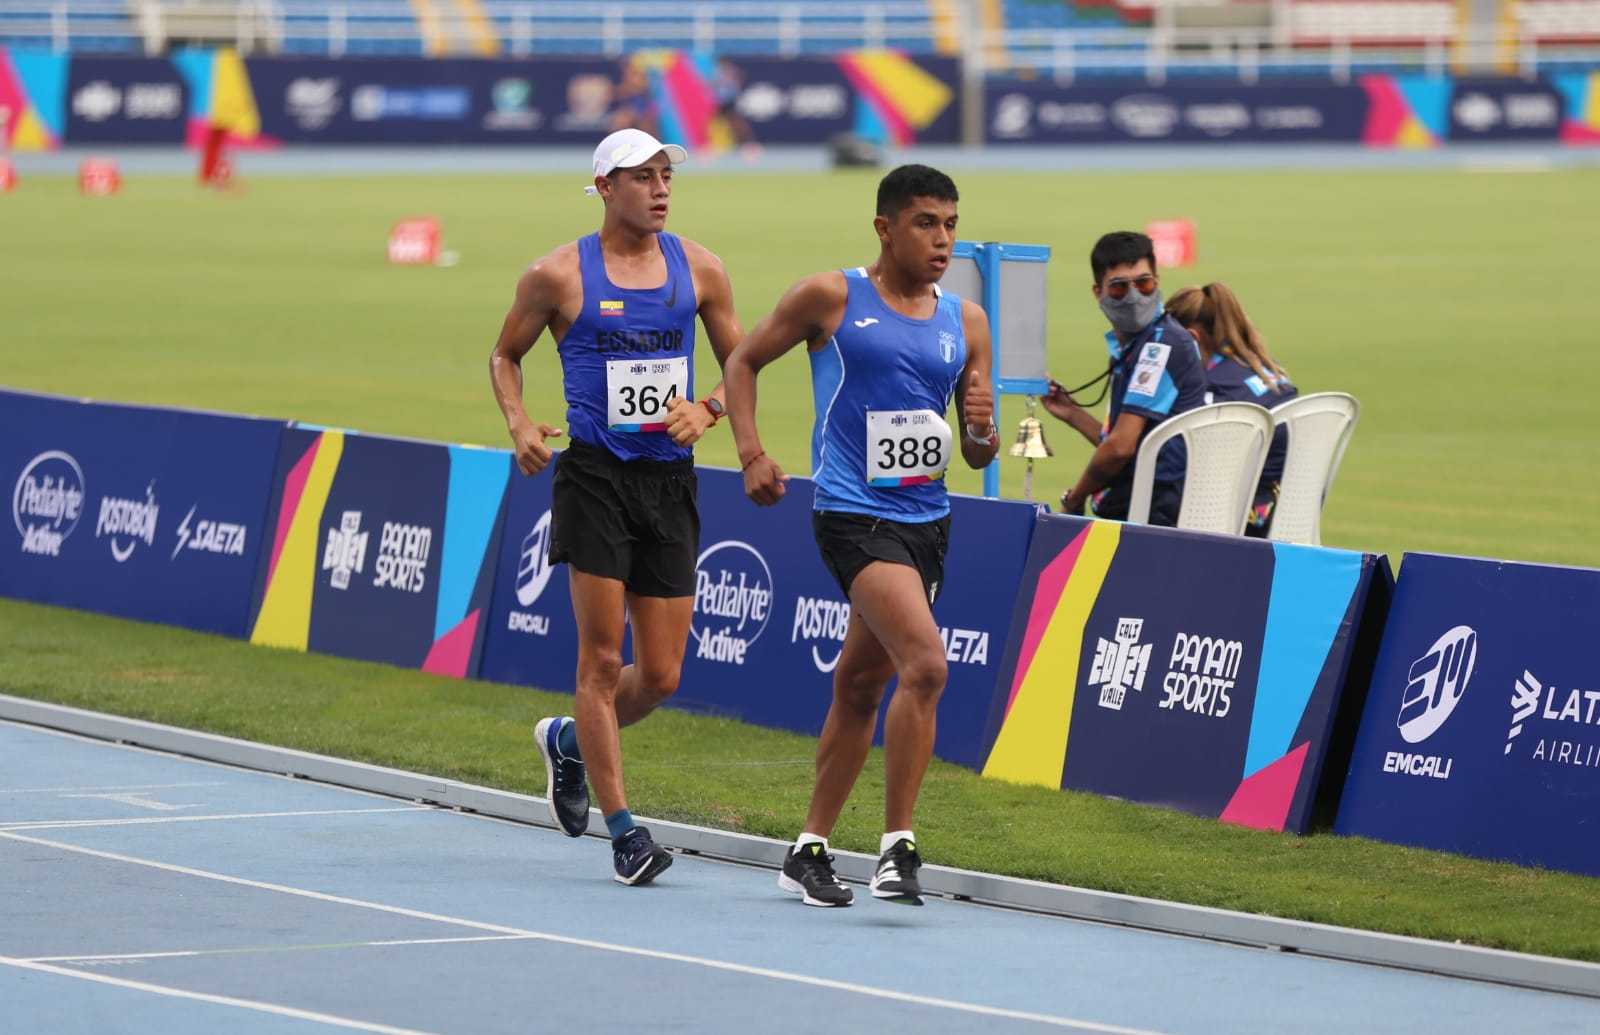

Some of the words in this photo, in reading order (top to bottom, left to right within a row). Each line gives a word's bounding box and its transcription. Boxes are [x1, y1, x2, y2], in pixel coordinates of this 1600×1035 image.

[596, 329, 684, 353] ECUADOR
[618, 384, 677, 417] 364
[877, 436, 942, 470] 388
[20, 474, 82, 529] Pedialyte
[22, 523, 63, 557] Active
[188, 520, 246, 556] SAETA
[379, 521, 432, 559] PANAM
[373, 553, 427, 593] SPORTS
[694, 569, 770, 631] Pedialyte
[507, 611, 550, 636] EMCALI
[792, 596, 850, 643] POSTOB
[1119, 623, 1140, 639] CALI
[697, 626, 746, 665] Active
[936, 626, 989, 665] ETA
[1168, 632, 1243, 679] PANAM
[1102, 687, 1123, 706] VALLE
[1158, 671, 1235, 718] SPORTS
[1542, 686, 1600, 726] LAT
[1383, 751, 1453, 779] EMCALI
[1532, 738, 1600, 768] AIRLI
